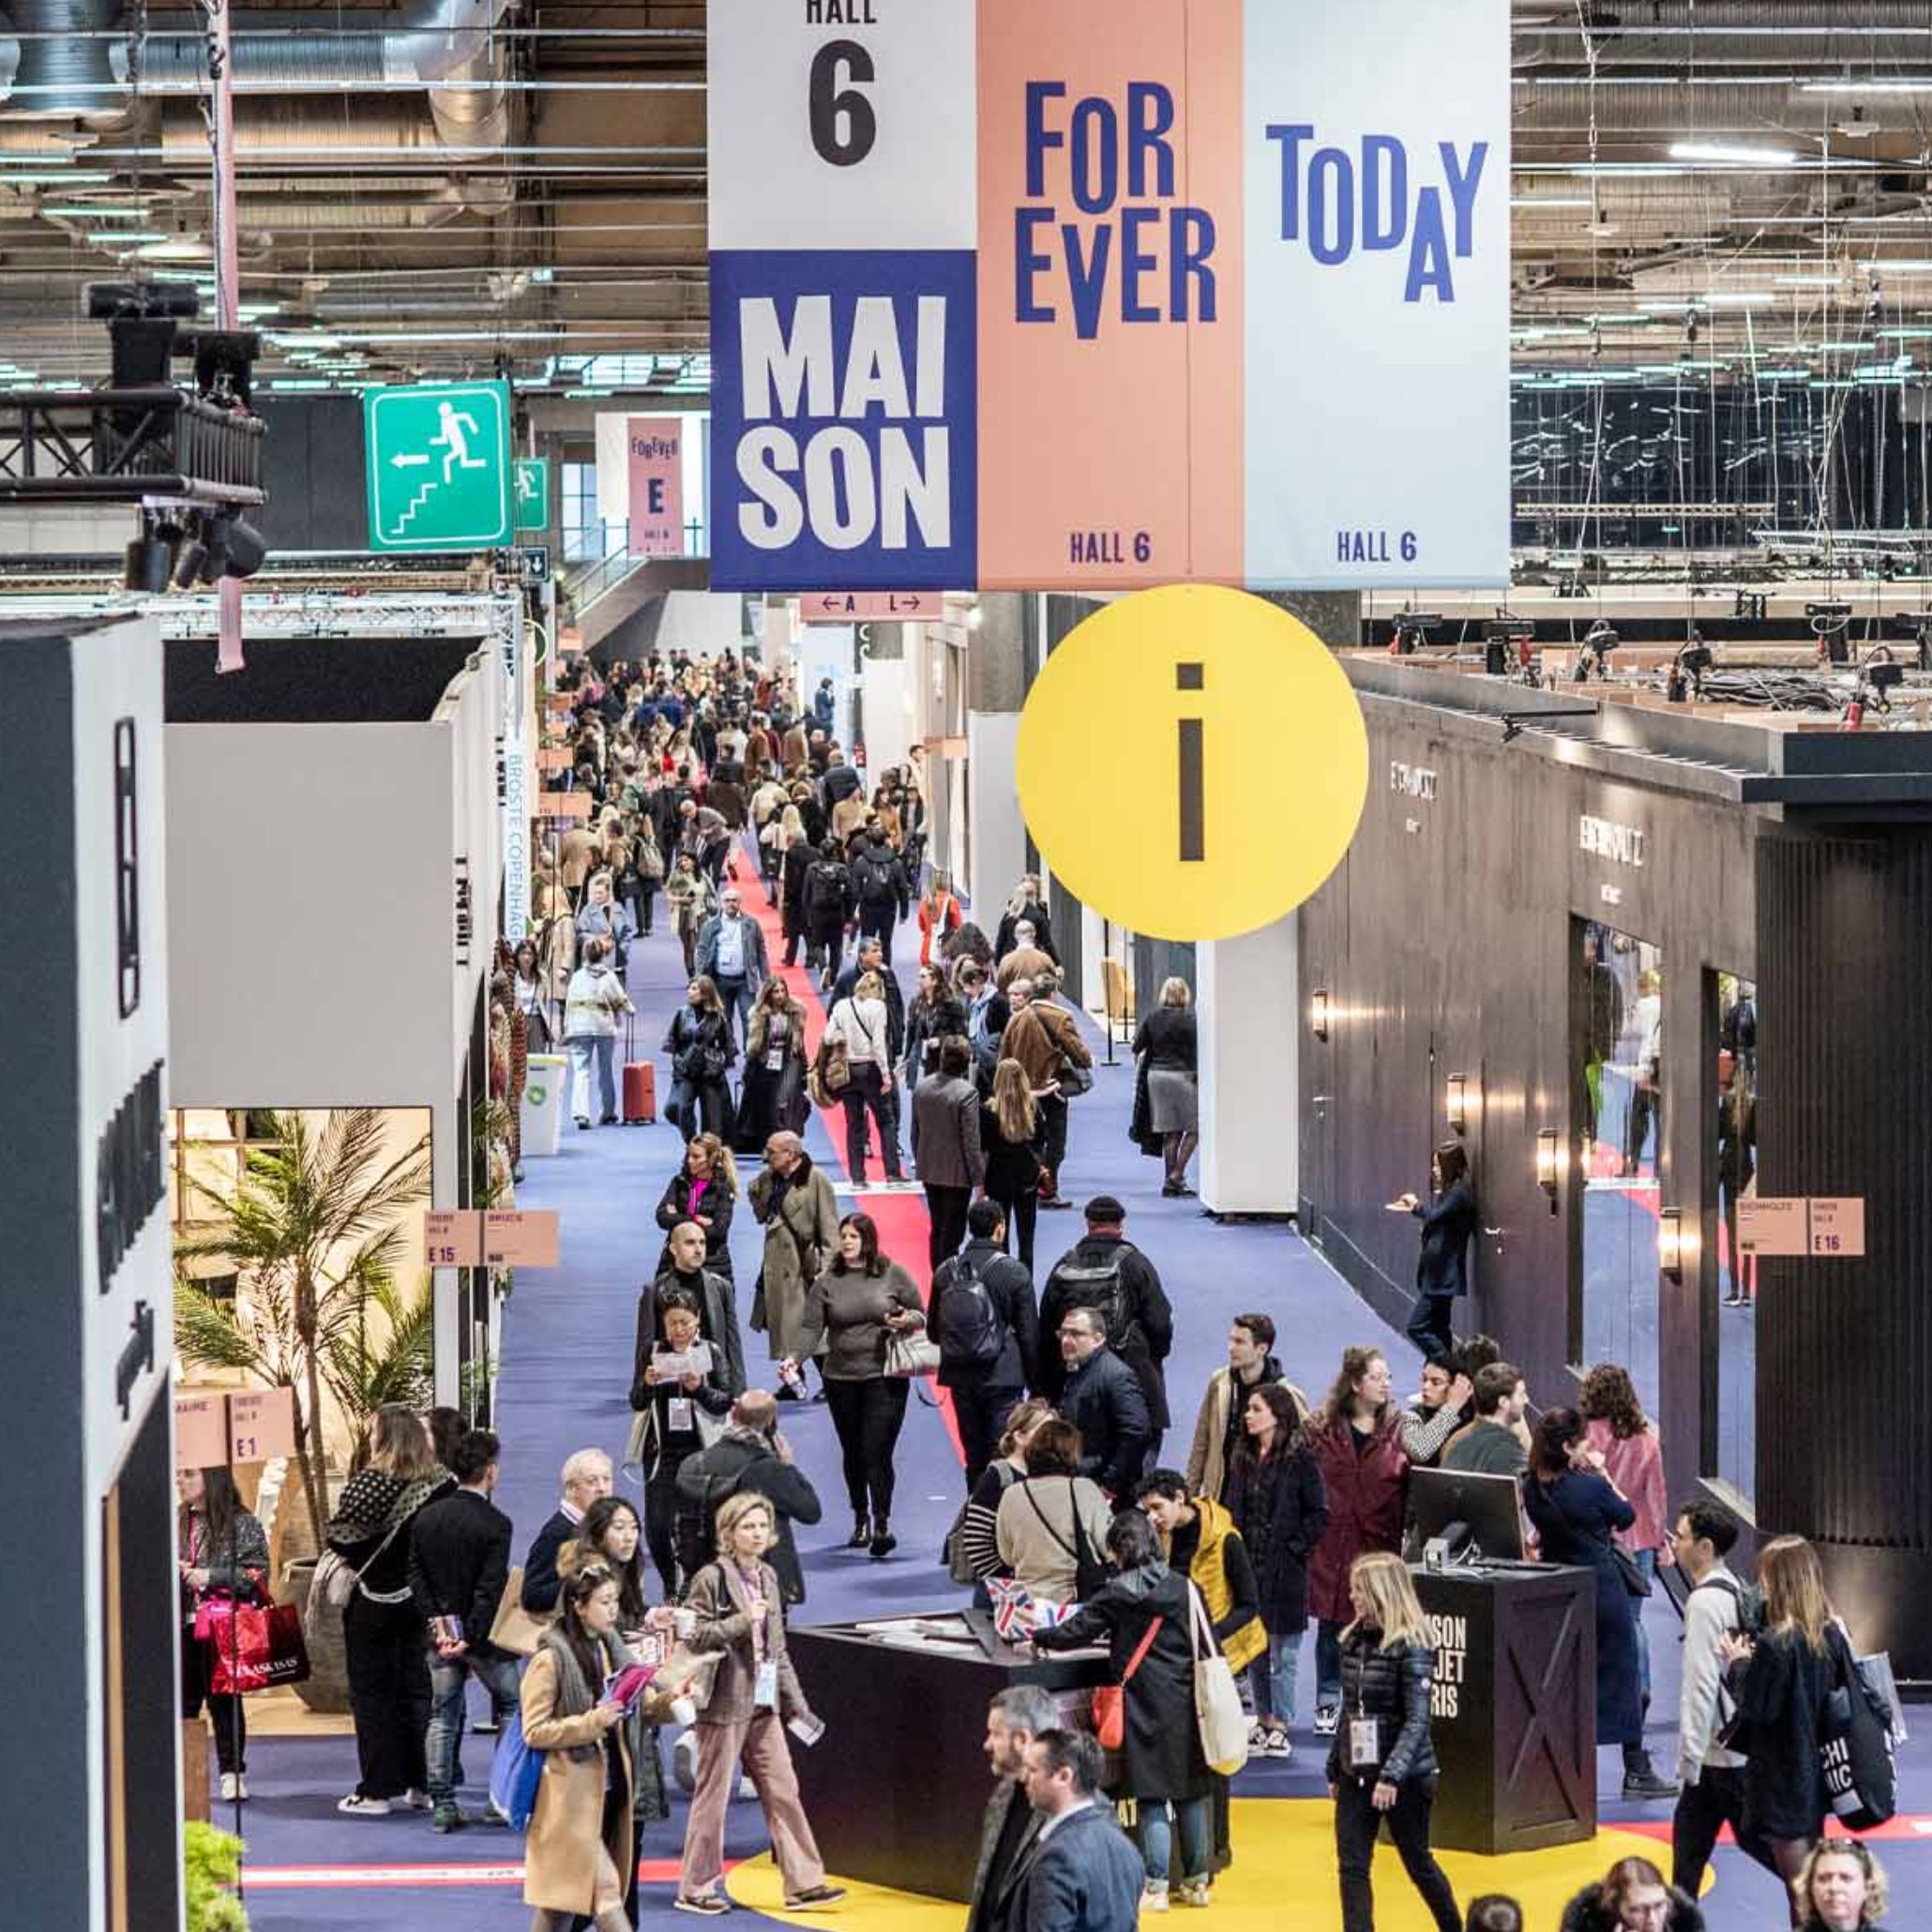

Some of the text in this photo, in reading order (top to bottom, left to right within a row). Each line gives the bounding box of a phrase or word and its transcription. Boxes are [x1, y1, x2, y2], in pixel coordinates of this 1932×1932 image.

[807, 0, 877, 23] HALL
[808, 39, 877, 167] 6
[1025, 82, 1175, 215] FOR
[1266, 125, 1488, 302] TODAY
[1015, 206, 1217, 340] EVER
[739, 294, 946, 420] MAI
[648, 478, 664, 514] E
[736, 426, 951, 551] SON
[1070, 532, 1151, 563] HALL 6
[1337, 531, 1418, 563] HALL 6
[846, 595, 855, 611] A
[890, 595, 898, 611] L
[507, 833, 523, 941] COPENHAG
[428, 1247, 455, 1263] E 15
[1815, 1235, 1840, 1251] E 16
[236, 1437, 256, 1457] E 1
[1427, 1613, 1467, 1650] SON
[1433, 1648, 1467, 1683] JET
[1430, 1683, 1458, 1719] RIS
